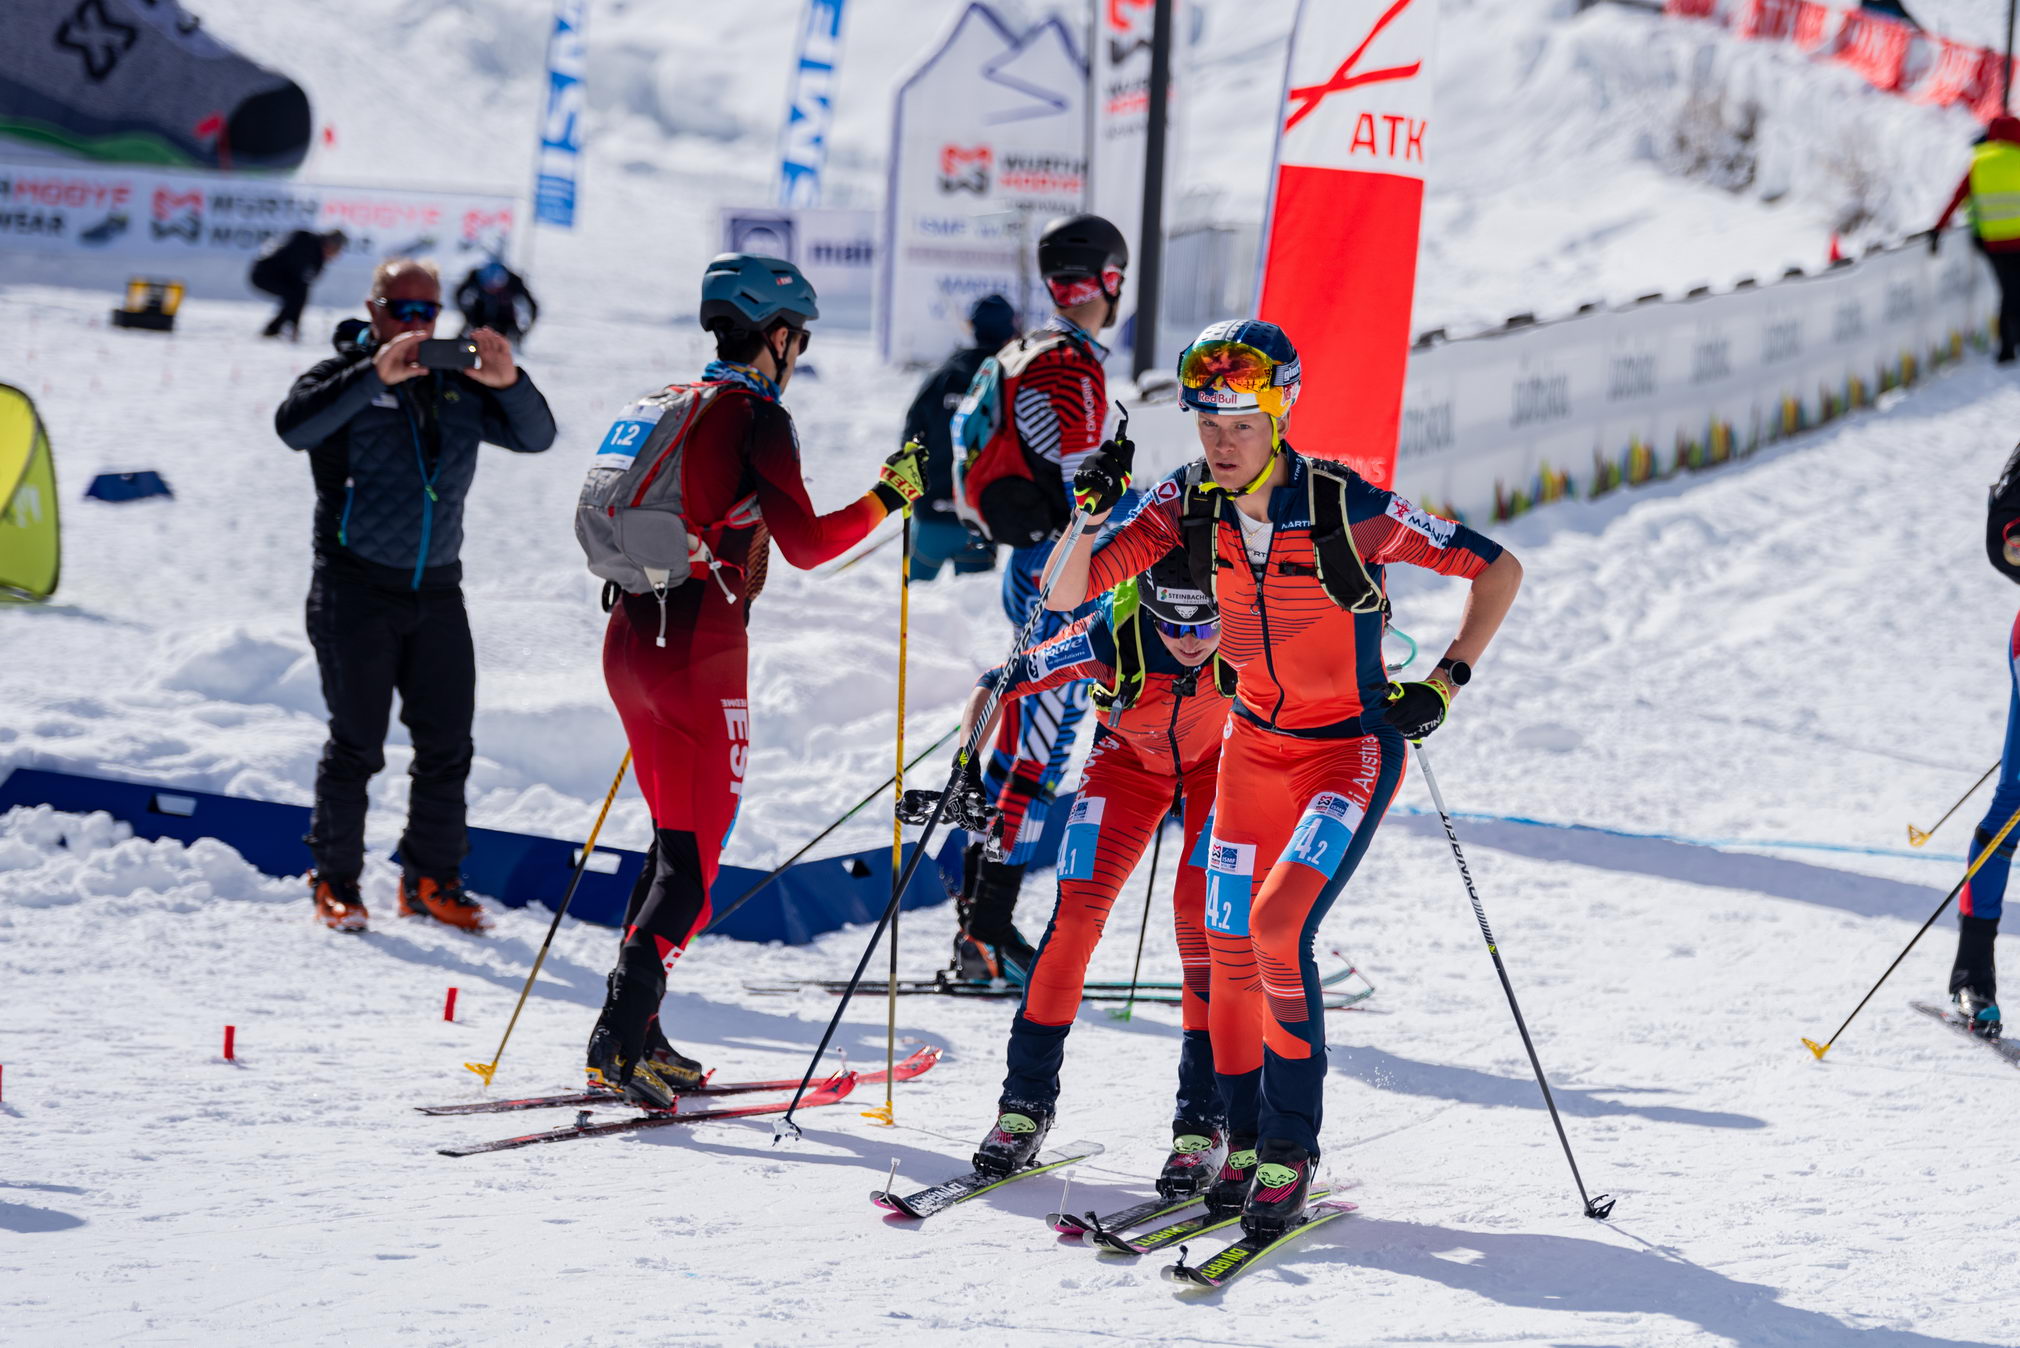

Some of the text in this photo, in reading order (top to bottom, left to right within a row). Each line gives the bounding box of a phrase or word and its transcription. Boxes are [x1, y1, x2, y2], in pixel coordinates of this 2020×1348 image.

[1350, 112, 1428, 162] ATK
[1080, 376, 1096, 432] DAVORIN
[1198, 390, 1238, 404] Red Bull
[610, 423, 641, 446] 1.2
[883, 469, 922, 500] LEKI
[1348, 736, 1378, 808] ki Austria
[1057, 829, 1077, 876] 4.1
[1295, 817, 1329, 866] 4.2
[1208, 875, 1232, 930] 4.2
